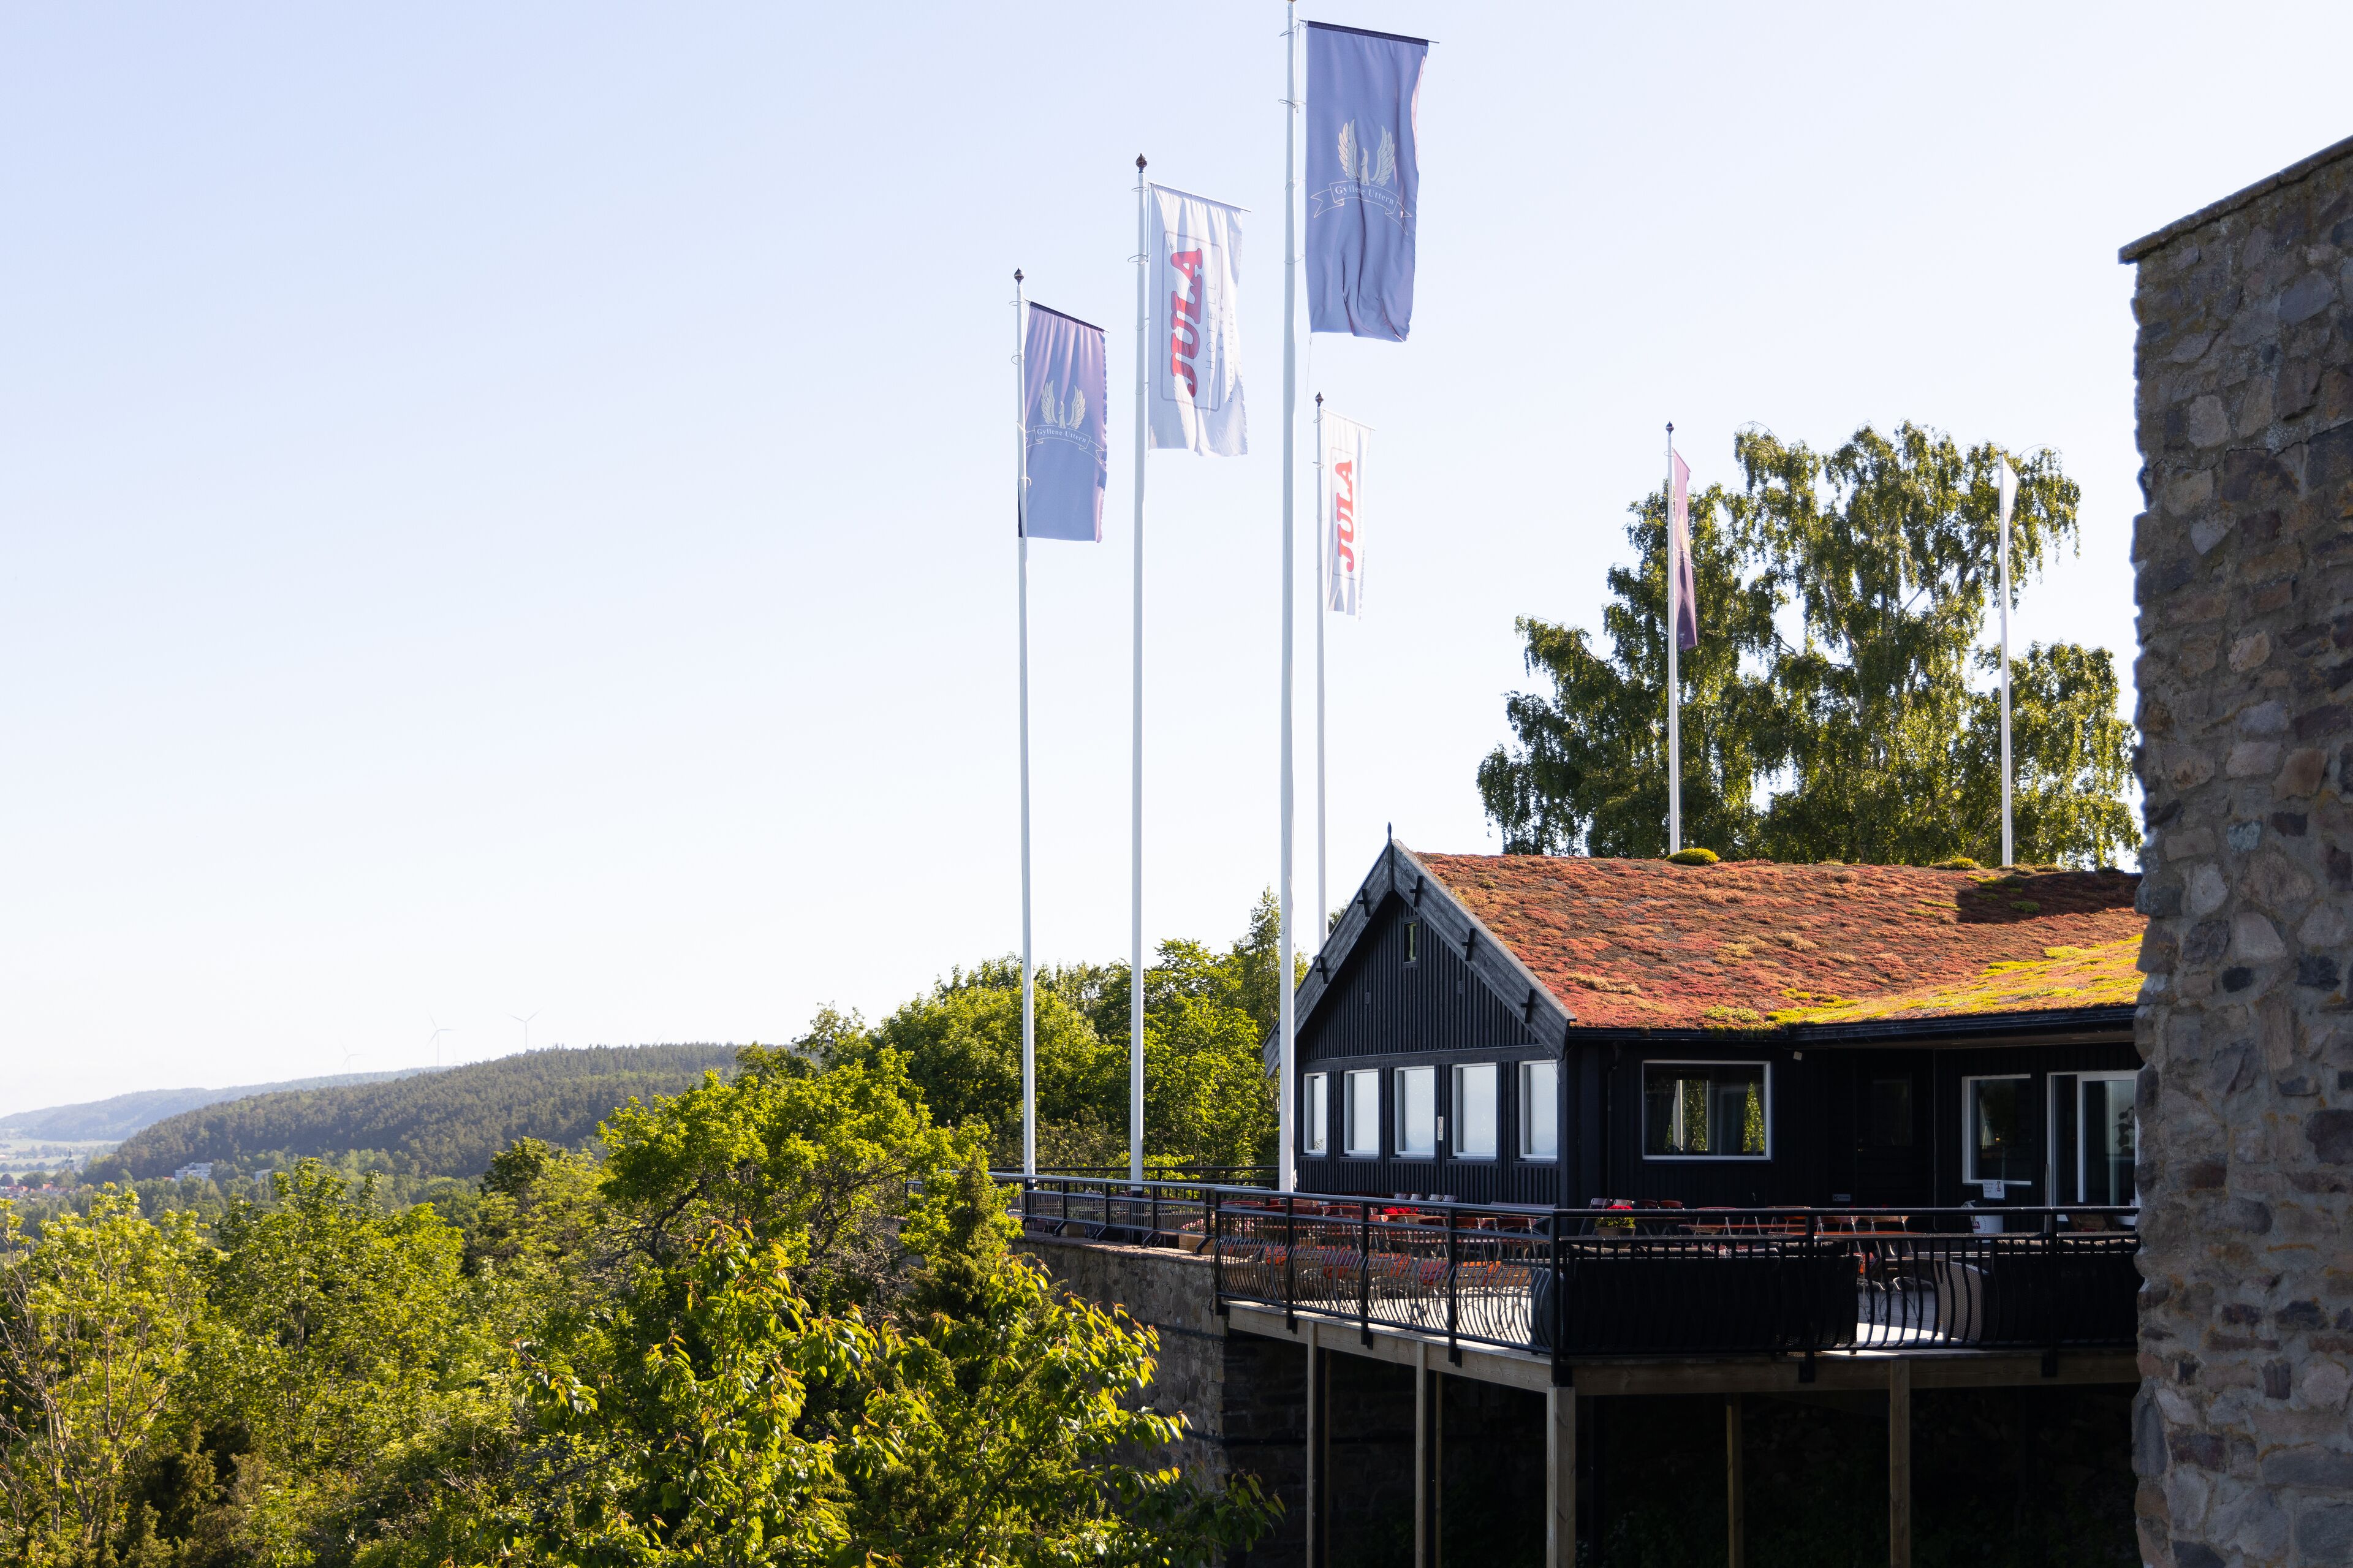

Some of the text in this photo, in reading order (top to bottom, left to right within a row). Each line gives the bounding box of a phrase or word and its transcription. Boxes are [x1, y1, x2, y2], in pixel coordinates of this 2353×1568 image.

[1335, 185, 1394, 205] Gyllee Uttern
[1170, 248, 1203, 398] JULA
[1205, 284, 1216, 370] HOTELL
[1065, 431, 1086, 442] Uttern
[1335, 460, 1354, 572] JULA
